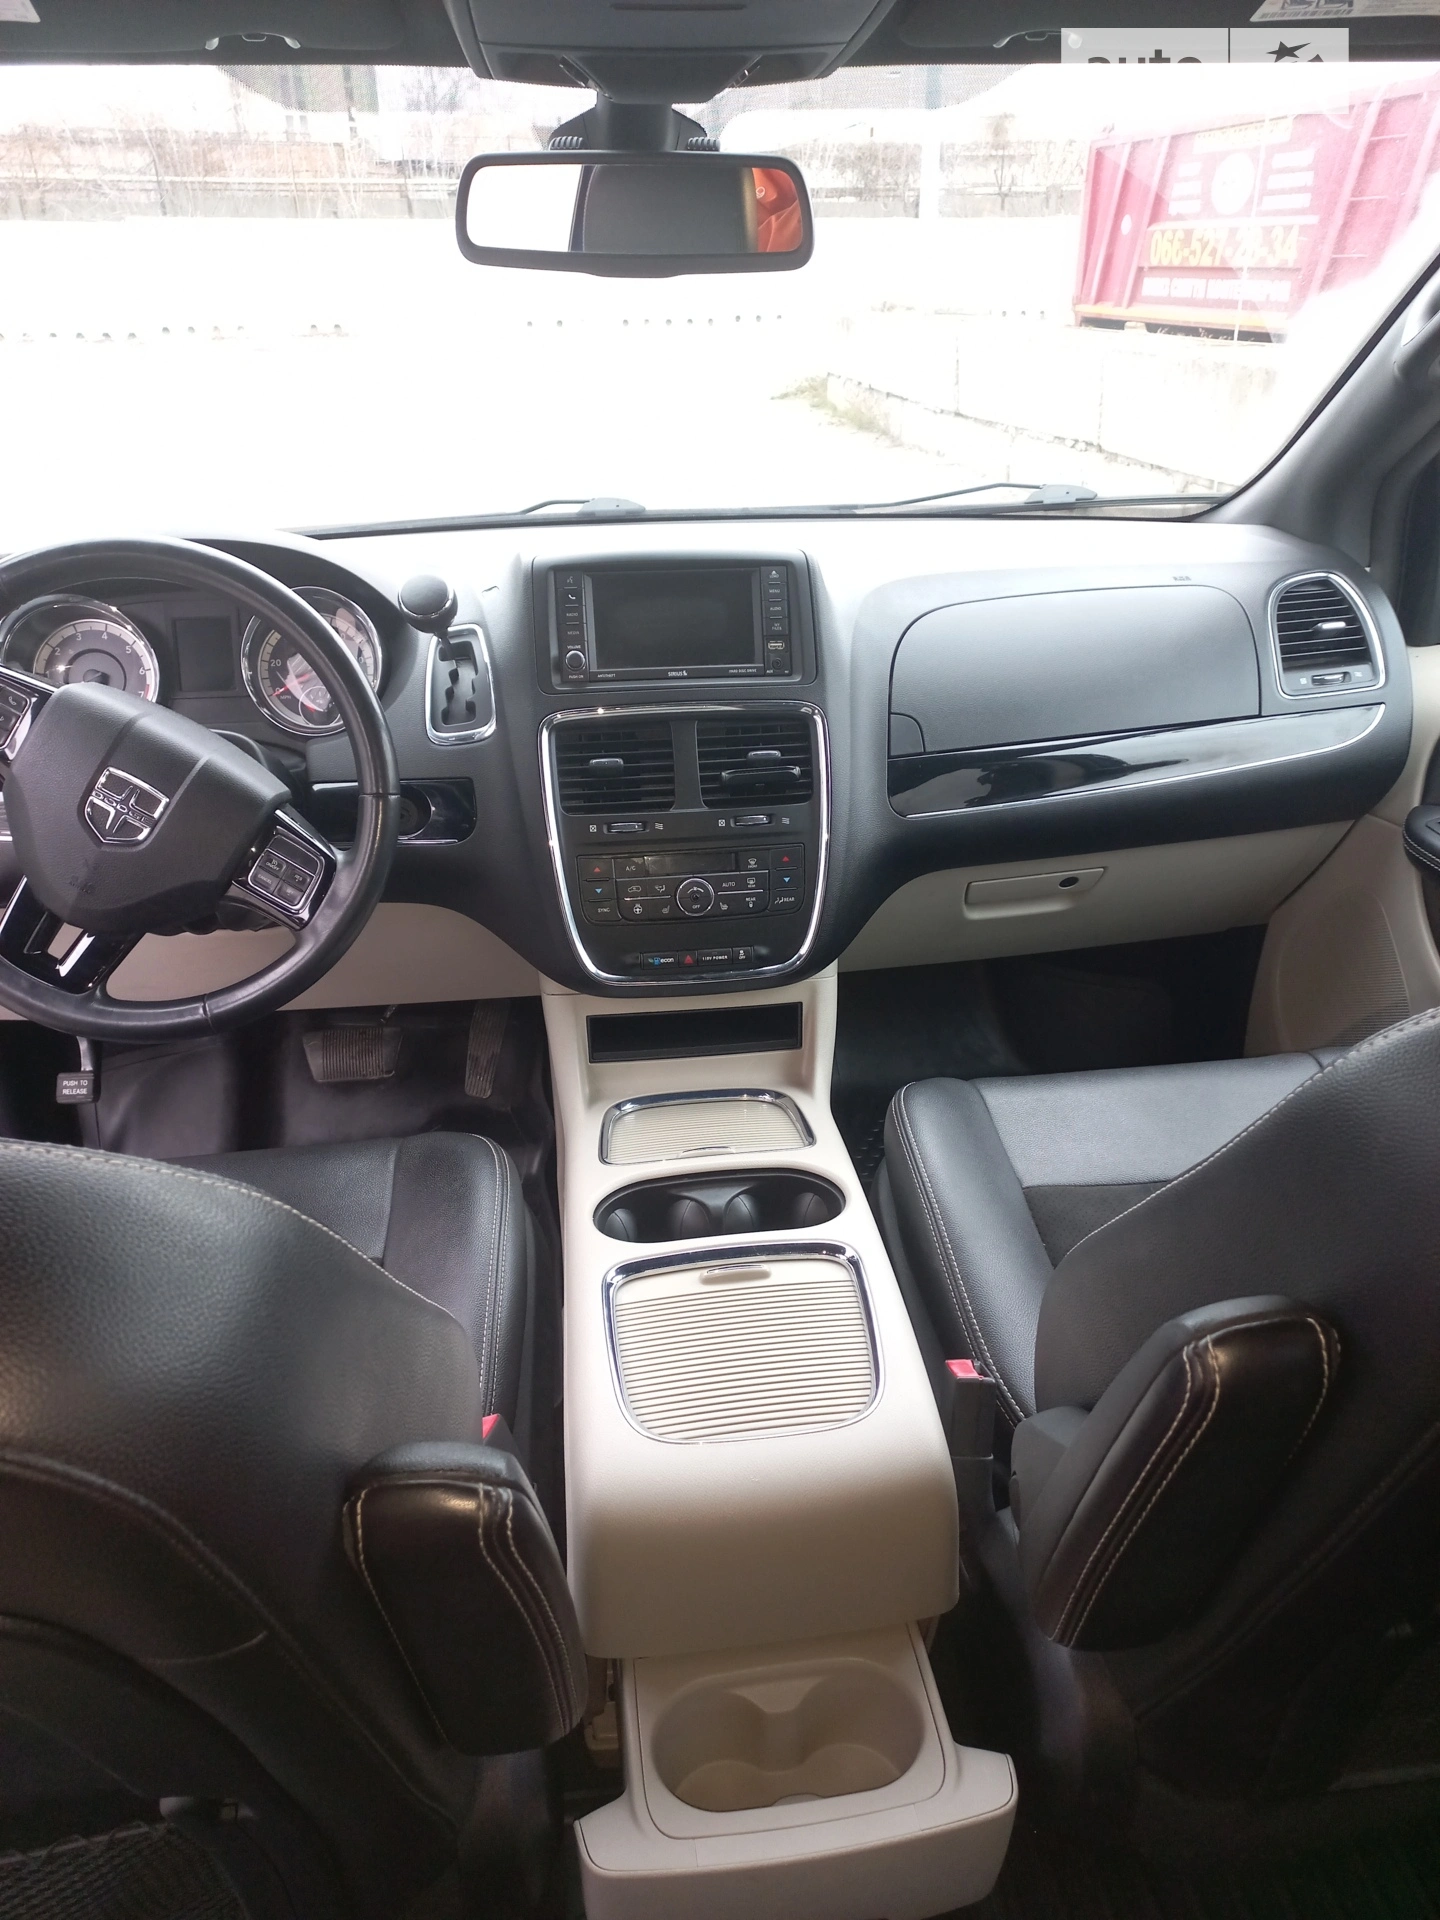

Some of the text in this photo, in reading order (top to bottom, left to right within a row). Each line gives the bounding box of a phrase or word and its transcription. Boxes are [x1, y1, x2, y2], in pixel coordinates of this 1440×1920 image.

[76, 633, 82, 641] 3
[101, 632, 108, 640] 4
[55, 647, 61, 656] 2
[125, 646, 132, 654] 5
[270, 658, 282, 667] 20
[139, 667, 146, 675] 6
[138, 691, 144, 699] 7
